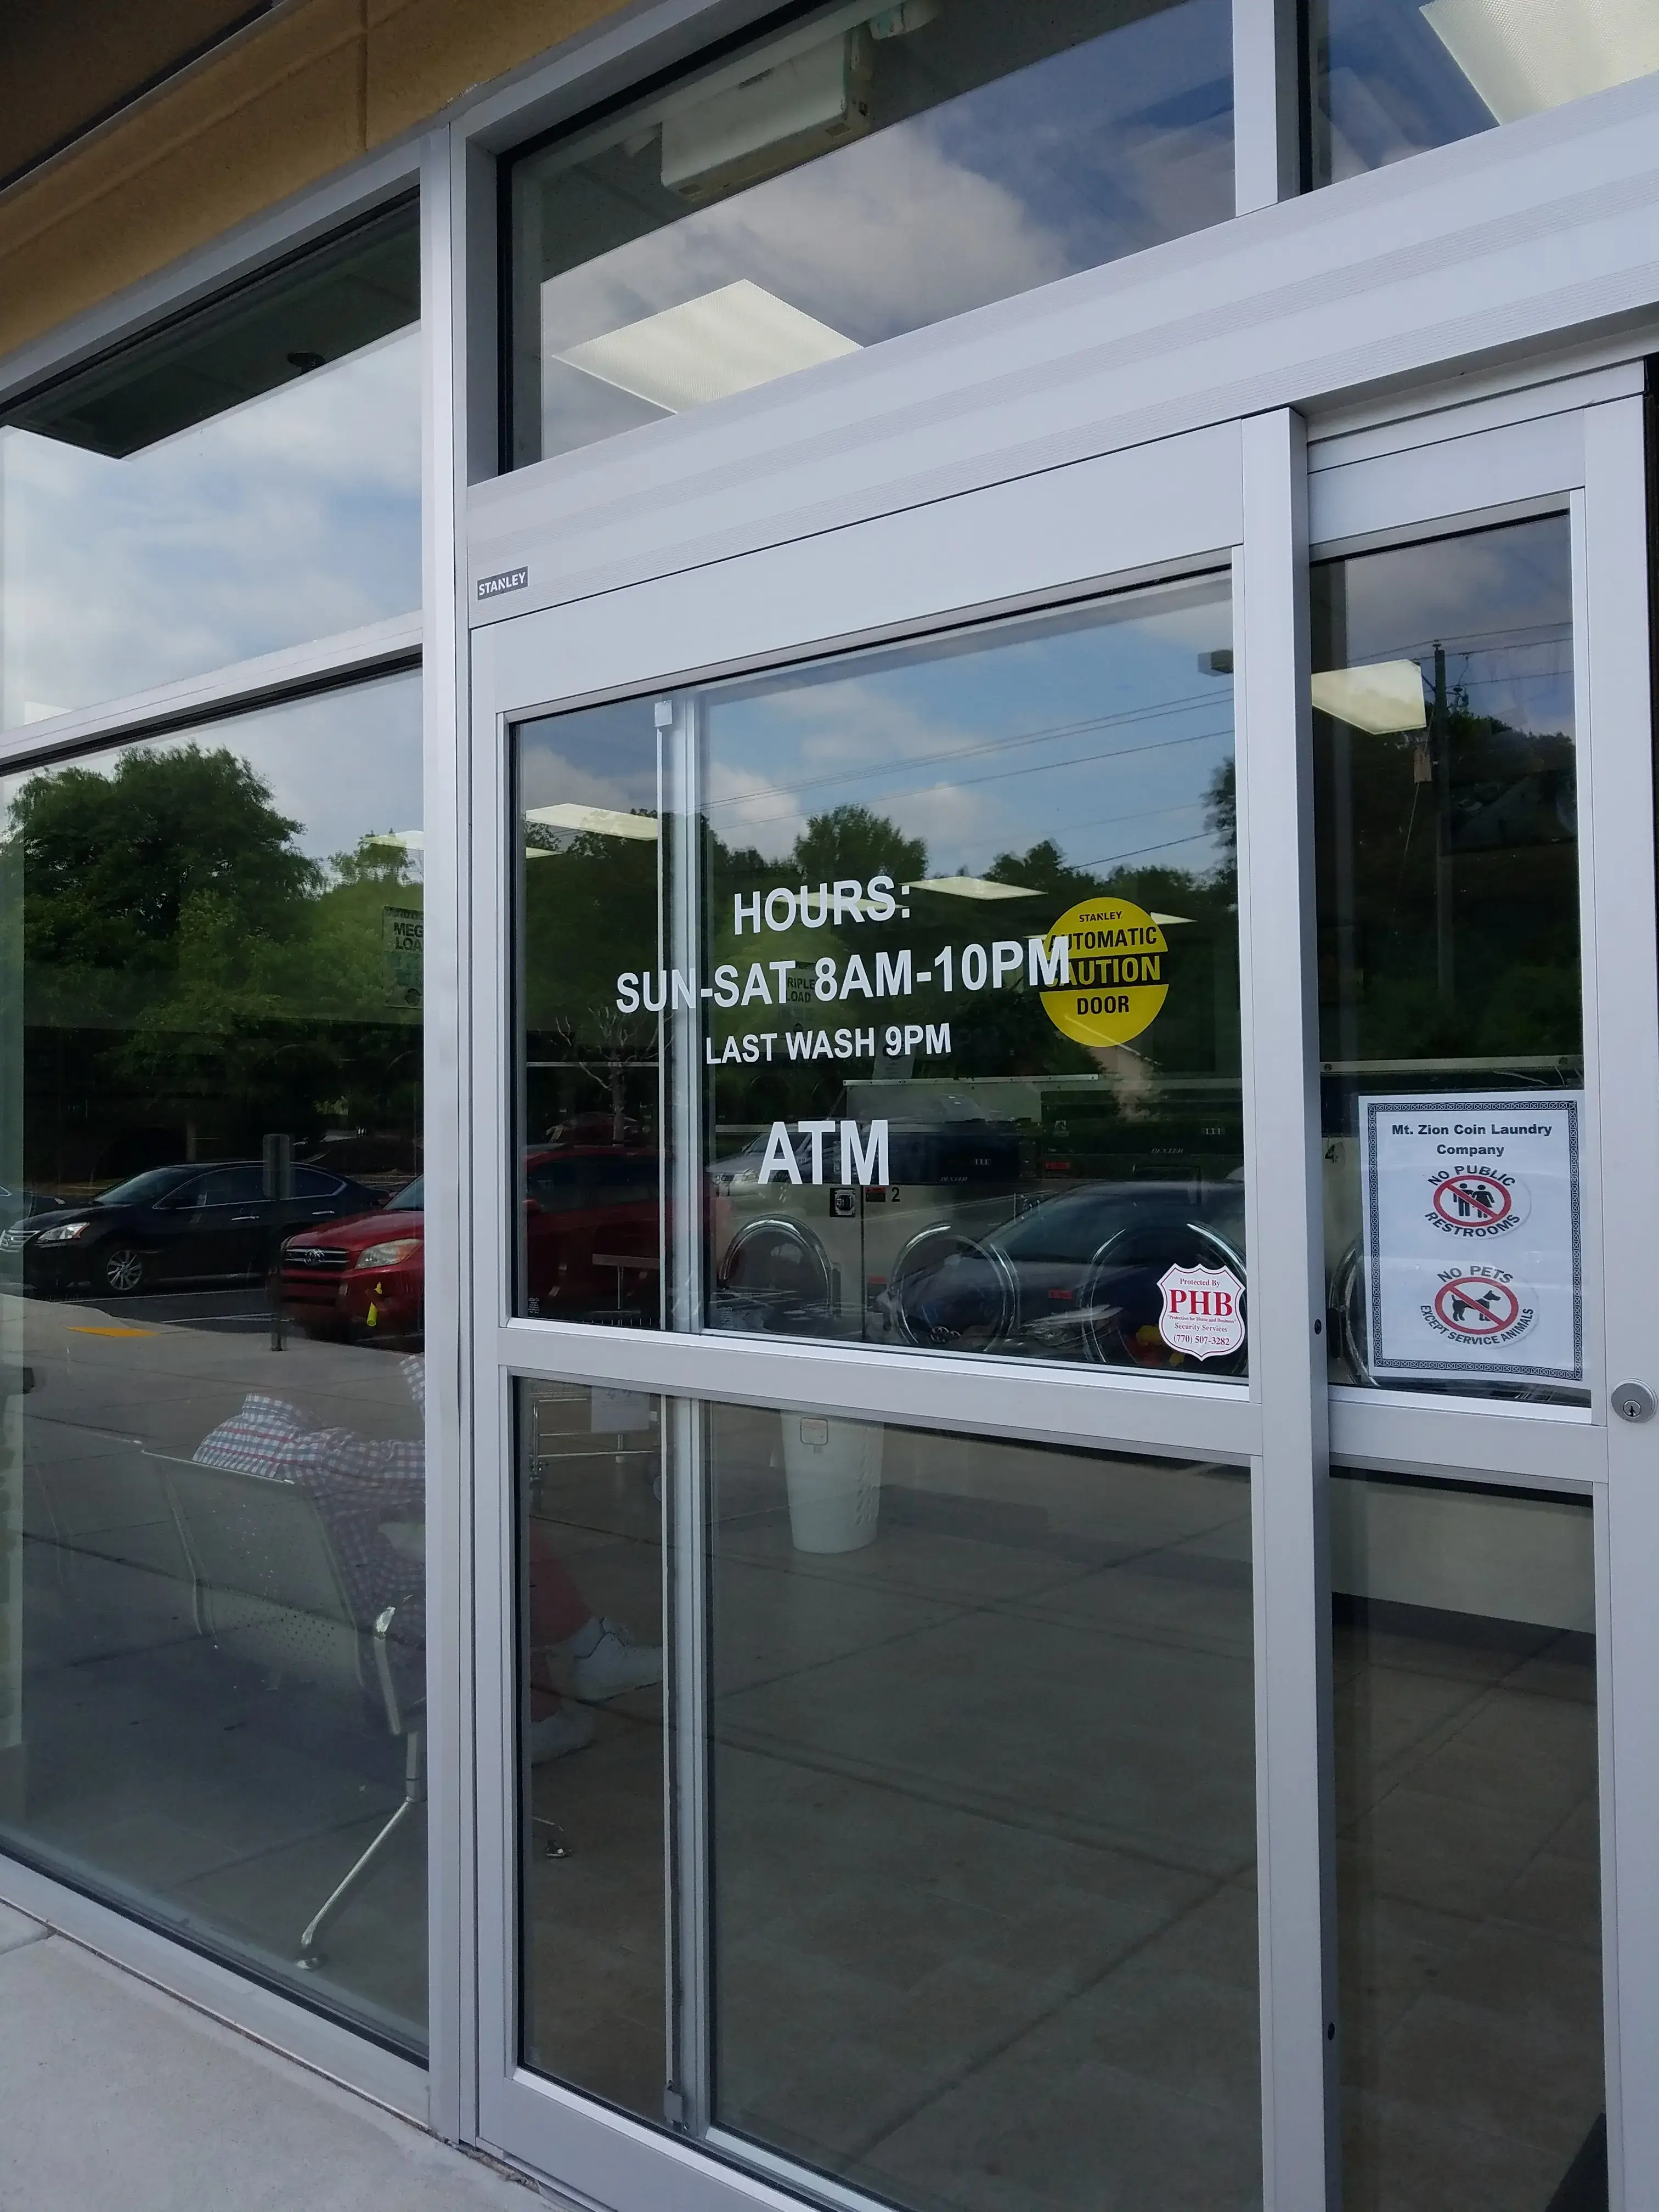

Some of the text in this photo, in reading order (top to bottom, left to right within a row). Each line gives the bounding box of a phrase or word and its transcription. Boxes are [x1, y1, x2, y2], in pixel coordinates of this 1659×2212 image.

[479, 572, 526, 596] STANLEY
[734, 876, 910, 935] HOURS:
[1079, 911, 1122, 922] STANLEY
[394, 922, 424, 938] MEG
[396, 936, 423, 951] LOA
[616, 936, 1069, 1013] SUN-SAT 8AM-10PM
[1045, 956, 1160, 987] AUTION
[787, 977, 815, 990] RIPLE
[1077, 995, 1129, 1015] DOOR
[707, 1023, 951, 1064] LAST WASH 9PM
[1392, 1124, 1552, 1136] Mt. Zion Coin Laundry
[758, 1120, 889, 1186] ATM
[1437, 1144, 1505, 1157] Company
[1427, 1165, 1516, 1186] NO PUBLIC
[891, 1187, 900, 1202] 2
[1424, 1211, 1520, 1237] RESTROOMS
[1212, 1279, 1221, 1288] By
[1437, 1265, 1513, 1284] NO PETS
[1169, 1289, 1233, 1316] PHB
[1175, 1323, 1228, 1333] Security Services
[1420, 1305, 1534, 1345] EXCEPT SERVICE ANIMALS
[1174, 1334, 1230, 1346] (770) 507-3282
